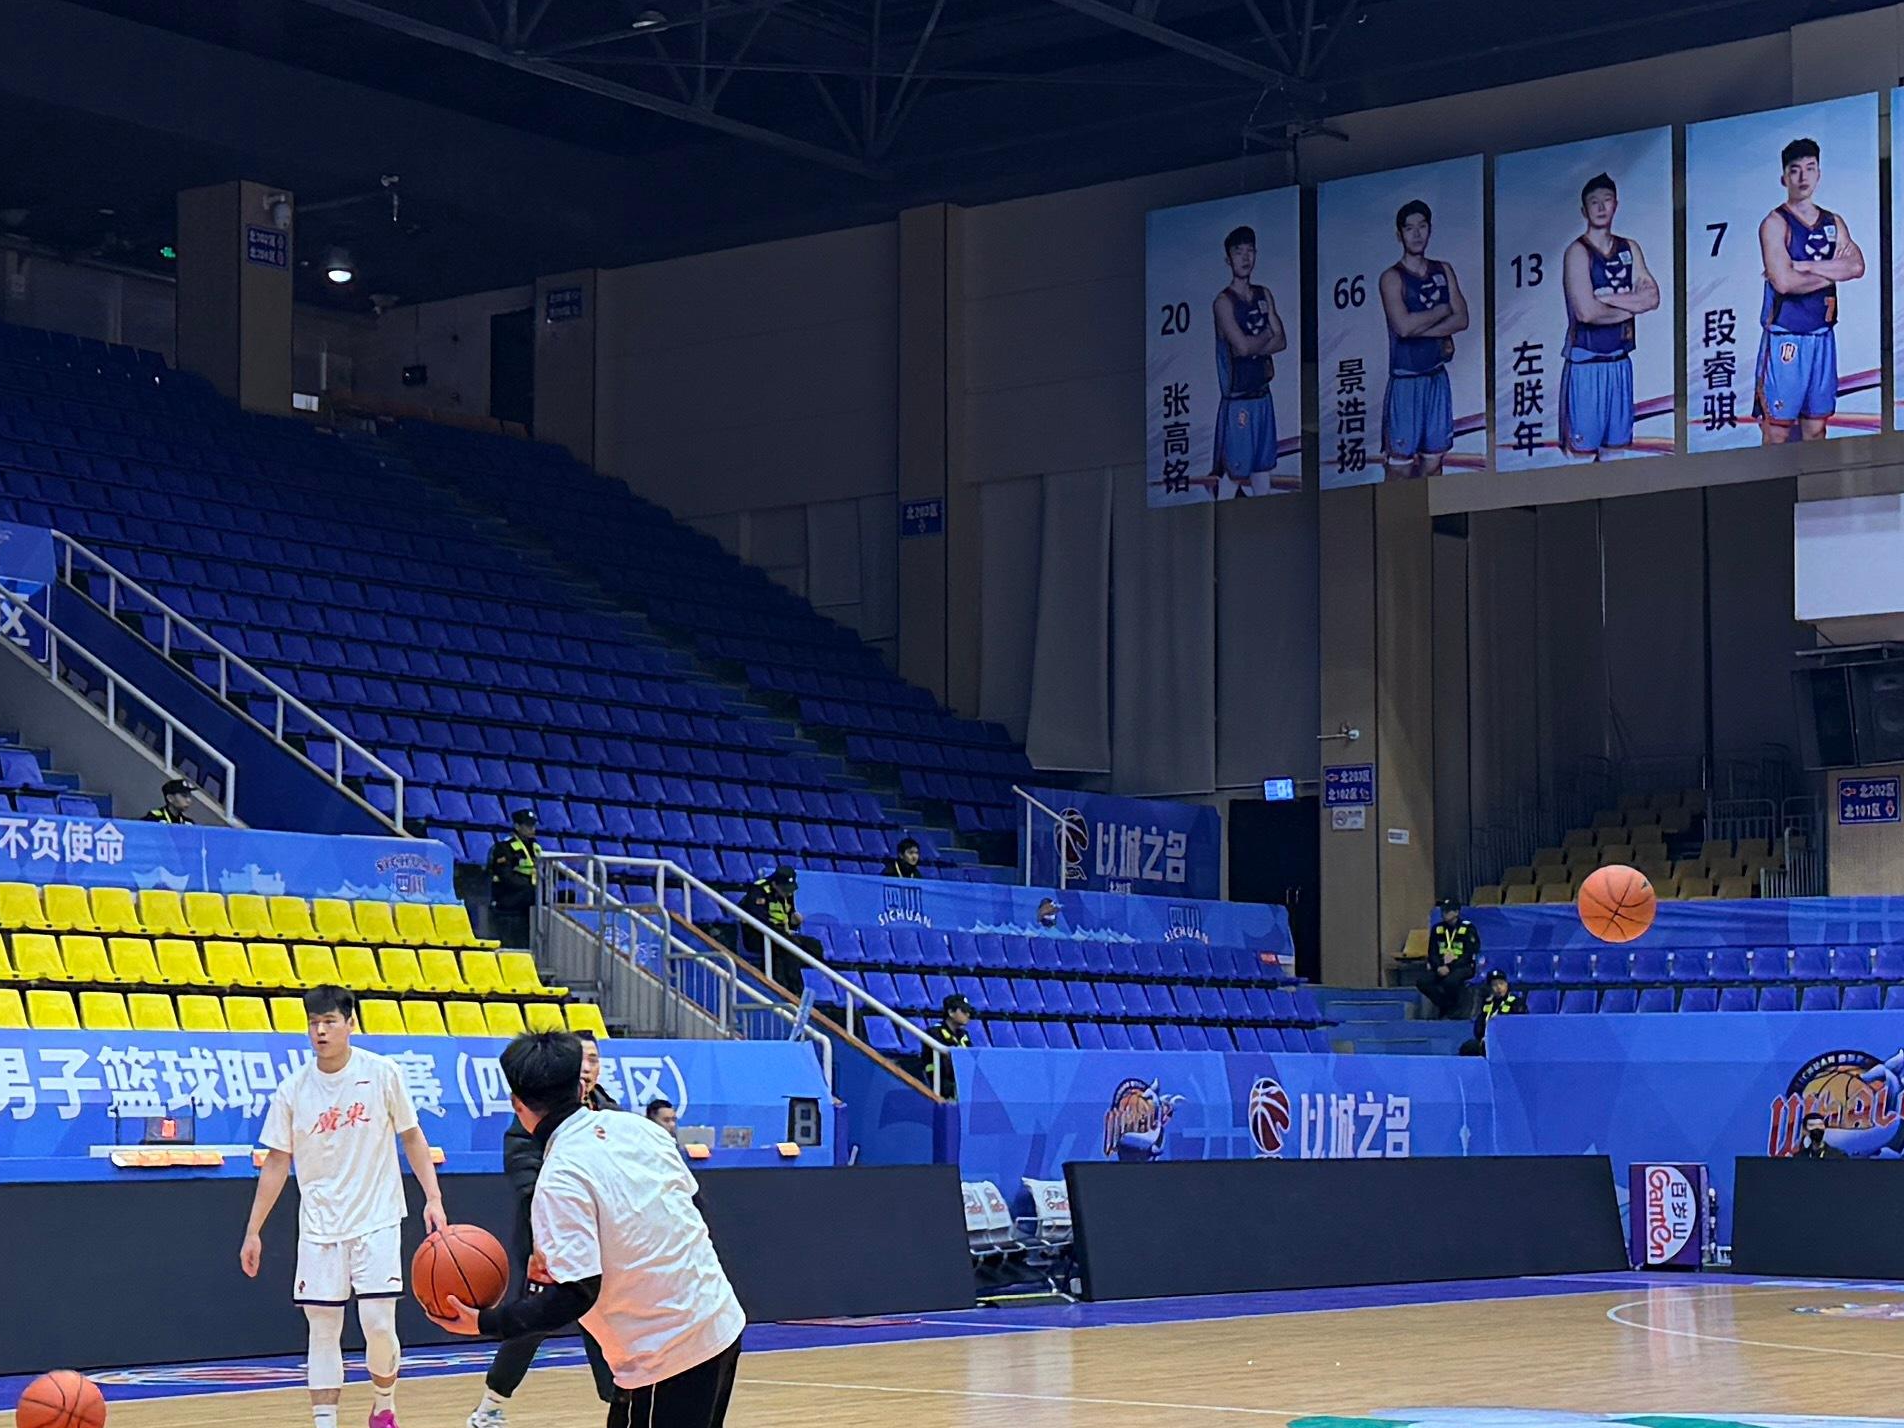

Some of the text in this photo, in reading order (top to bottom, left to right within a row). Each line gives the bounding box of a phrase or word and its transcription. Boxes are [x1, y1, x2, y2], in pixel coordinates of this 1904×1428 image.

[1706, 223, 1729, 258] 7
[1511, 253, 1544, 289] 13
[1334, 275, 1366, 310] 66
[1160, 302, 1191, 336] 20
[1336, 358, 1368, 474] 景浩扬
[1162, 383, 1191, 494] 张高铭
[877, 908, 933, 929] SICHUAN
[1163, 925, 1210, 945] SICHUAN
